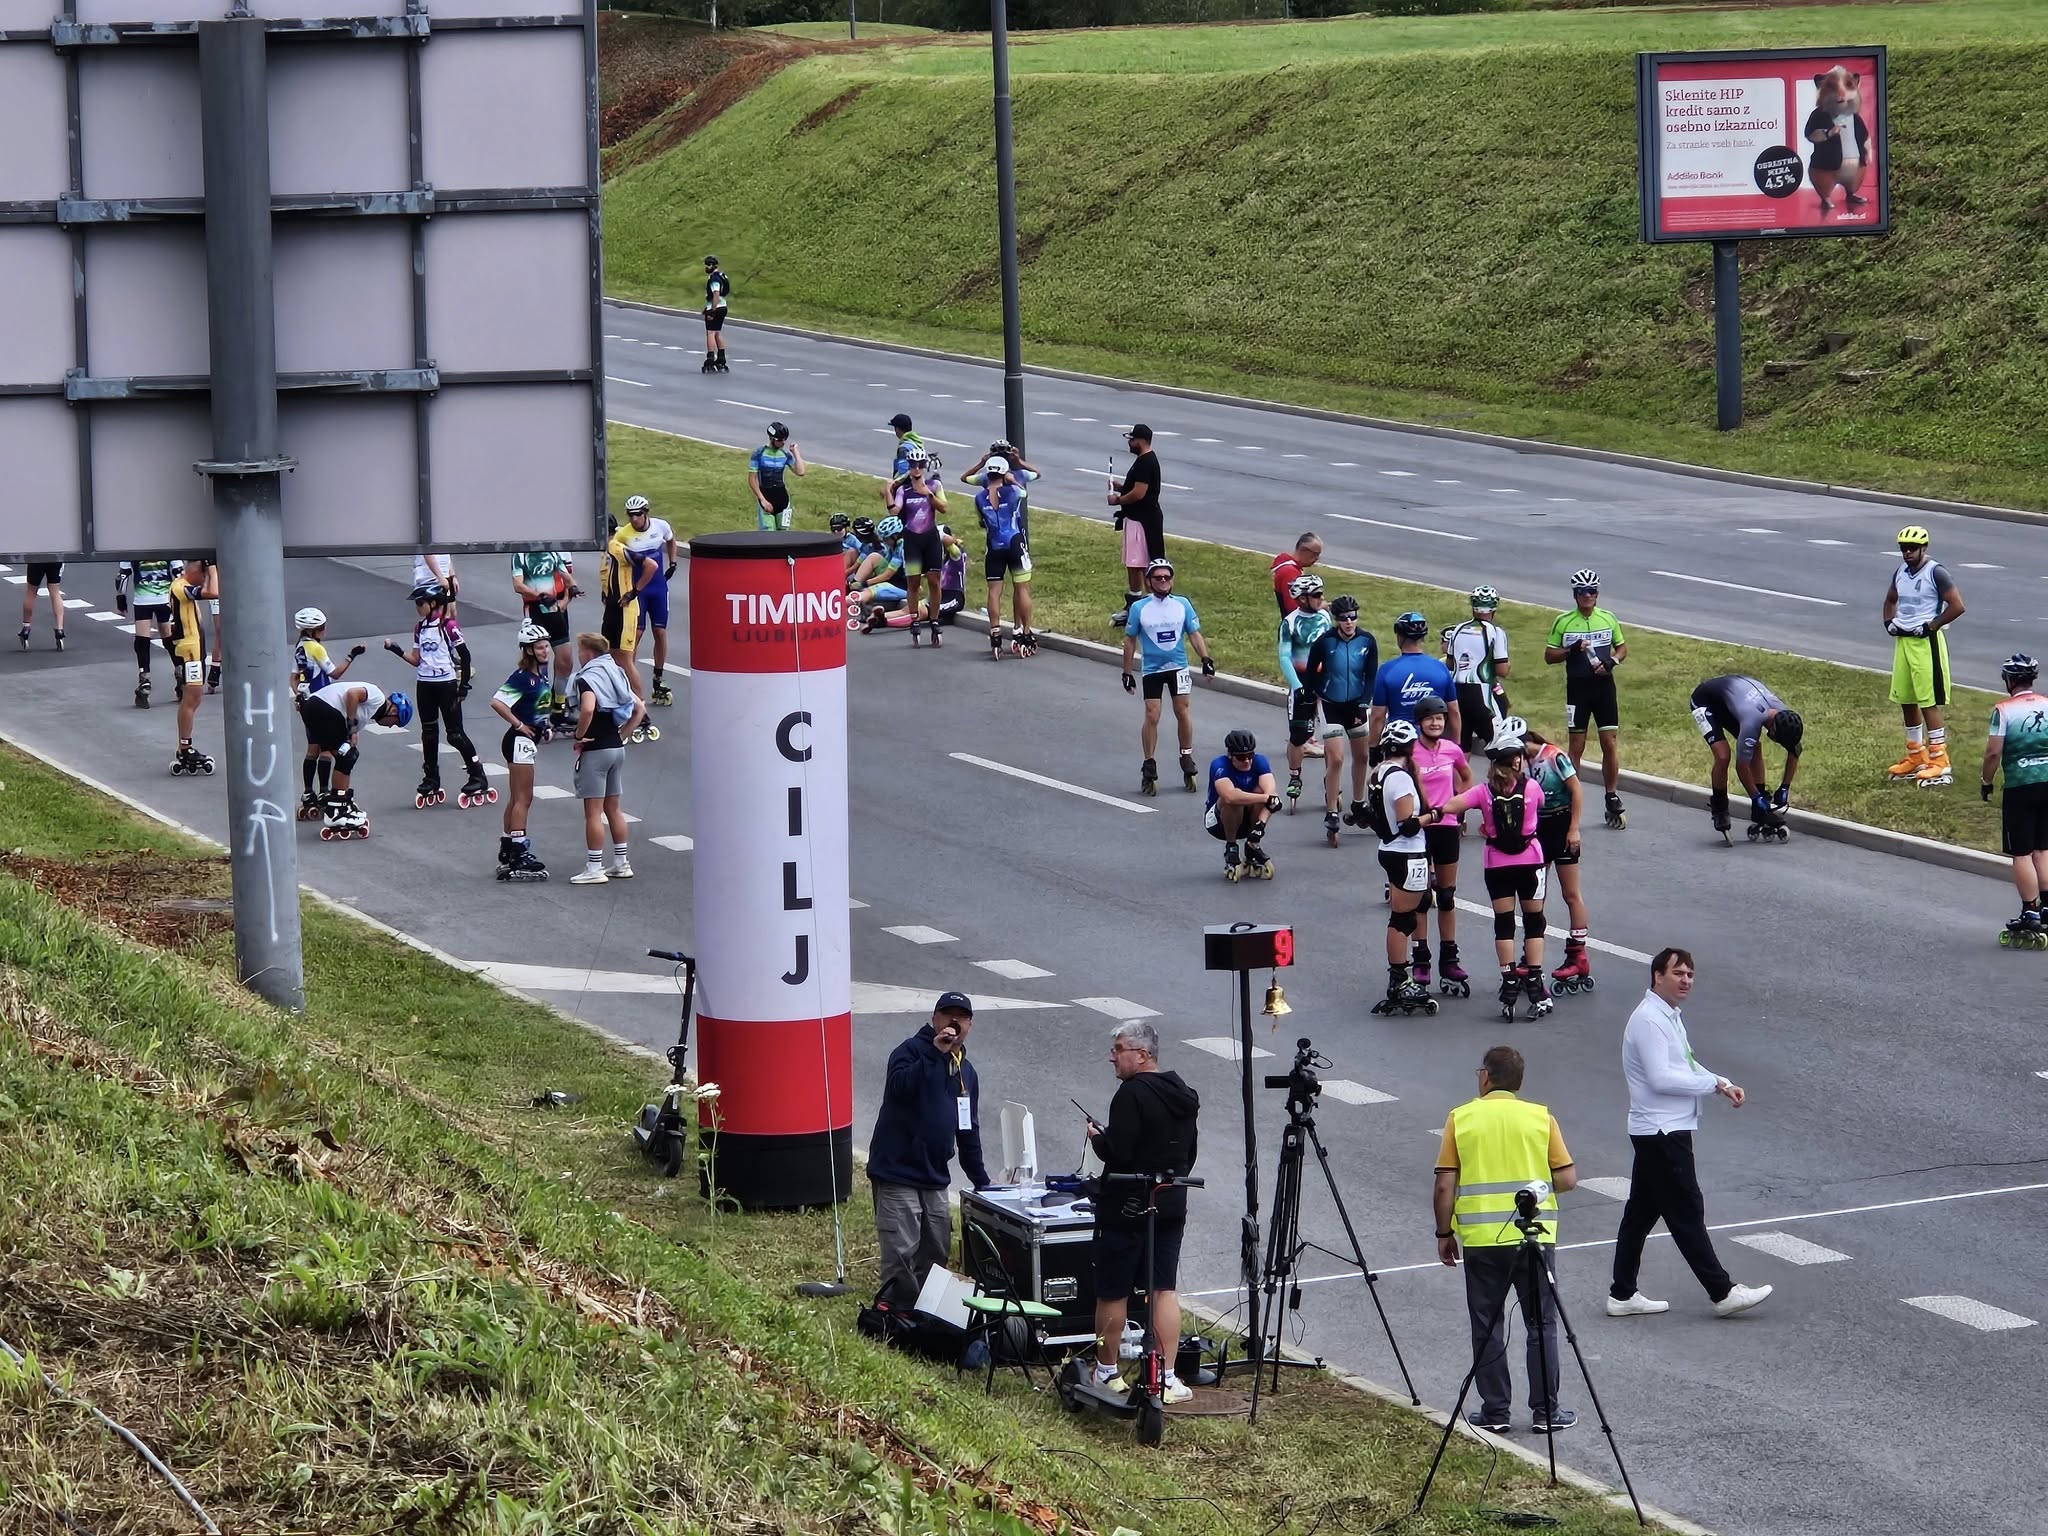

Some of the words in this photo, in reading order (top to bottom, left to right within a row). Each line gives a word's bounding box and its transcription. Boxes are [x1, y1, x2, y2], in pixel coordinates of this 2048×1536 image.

[1665, 89, 1717, 101] Sklenite
[1720, 88, 1744, 100] HIP
[1666, 105, 1704, 117] kredit
[1706, 106, 1740, 116] samo
[1743, 106, 1751, 115] z
[1666, 121, 1711, 133] osebno
[1714, 118, 1778, 132] izkaznico!
[725, 588, 842, 625] TIMING
[775, 711, 813, 986] CILJ
